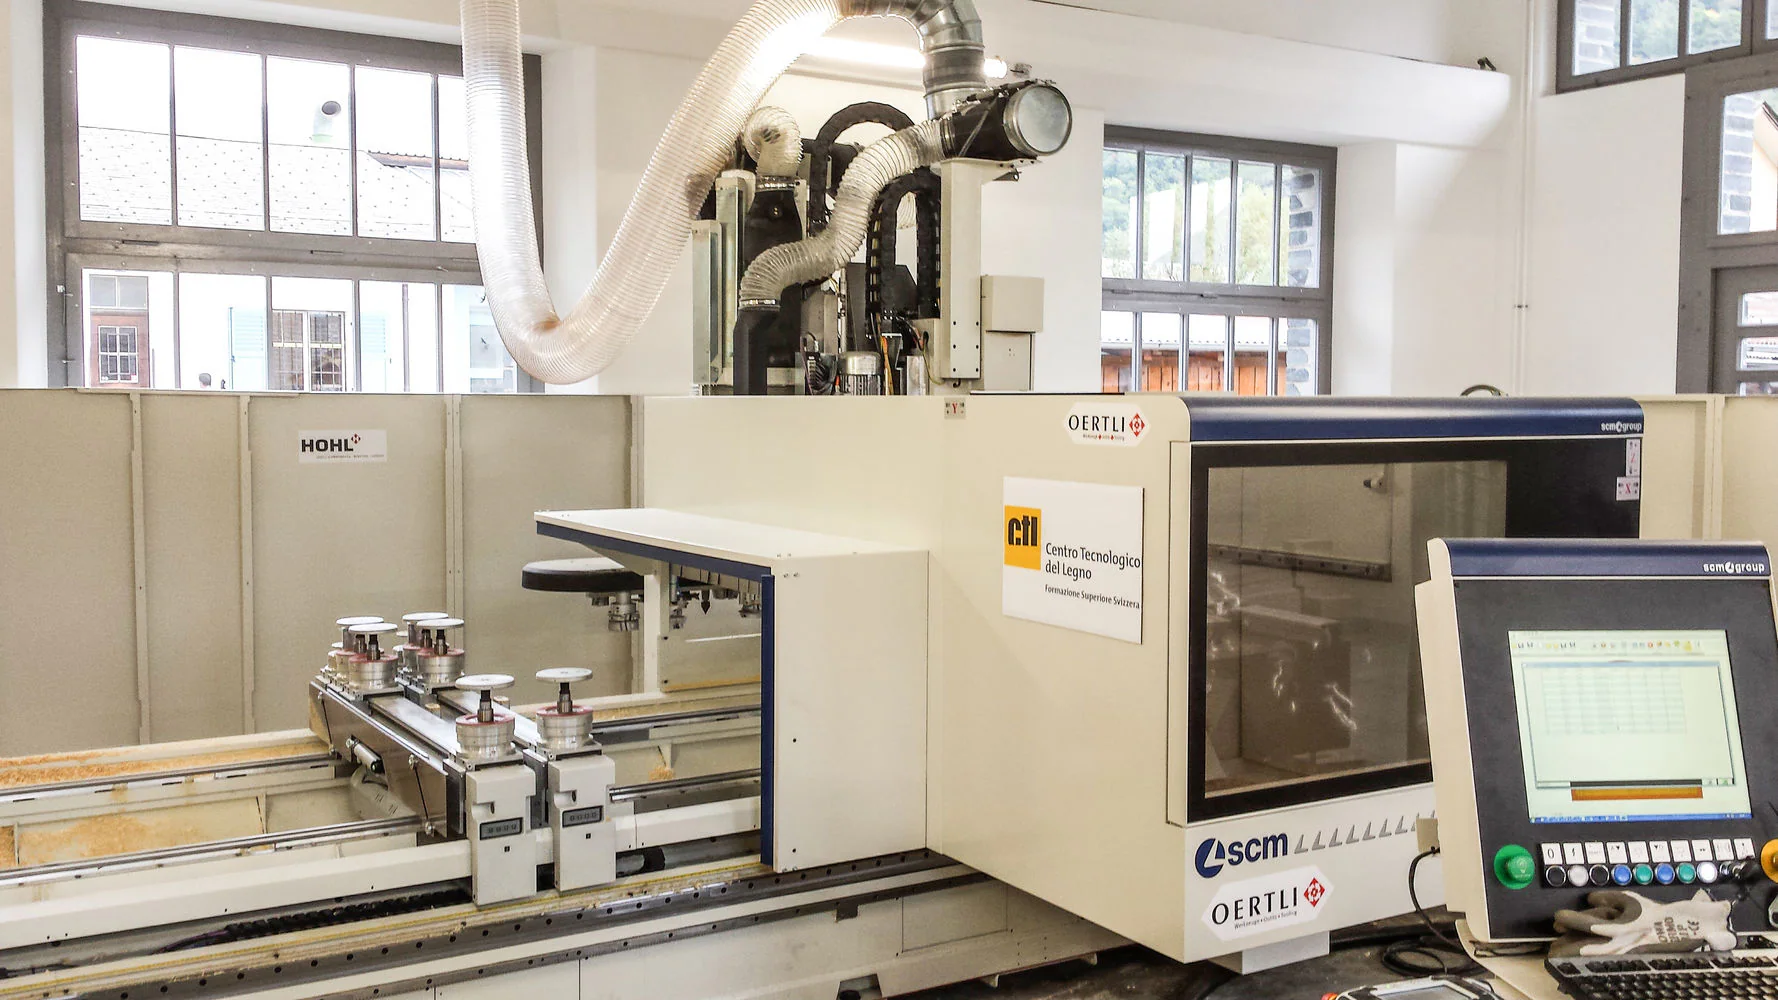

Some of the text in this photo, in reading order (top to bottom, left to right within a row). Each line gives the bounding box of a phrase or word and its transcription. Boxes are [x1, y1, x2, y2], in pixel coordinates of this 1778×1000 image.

[1068, 414, 1125, 433] OERTLI
[1622, 422, 1642, 433] group
[301, 439, 354, 453] HOHL
[1007, 514, 1038, 547] ctl
[1045, 542, 1141, 571] Centro Tecnologico
[1703, 563, 1765, 574] scm group
[1045, 559, 1092, 582] del Legno
[1044, 584, 1140, 609] Formazione Superiore Svizzera
[1228, 832, 1288, 866] scm
[1211, 886, 1298, 925] OERTLI
